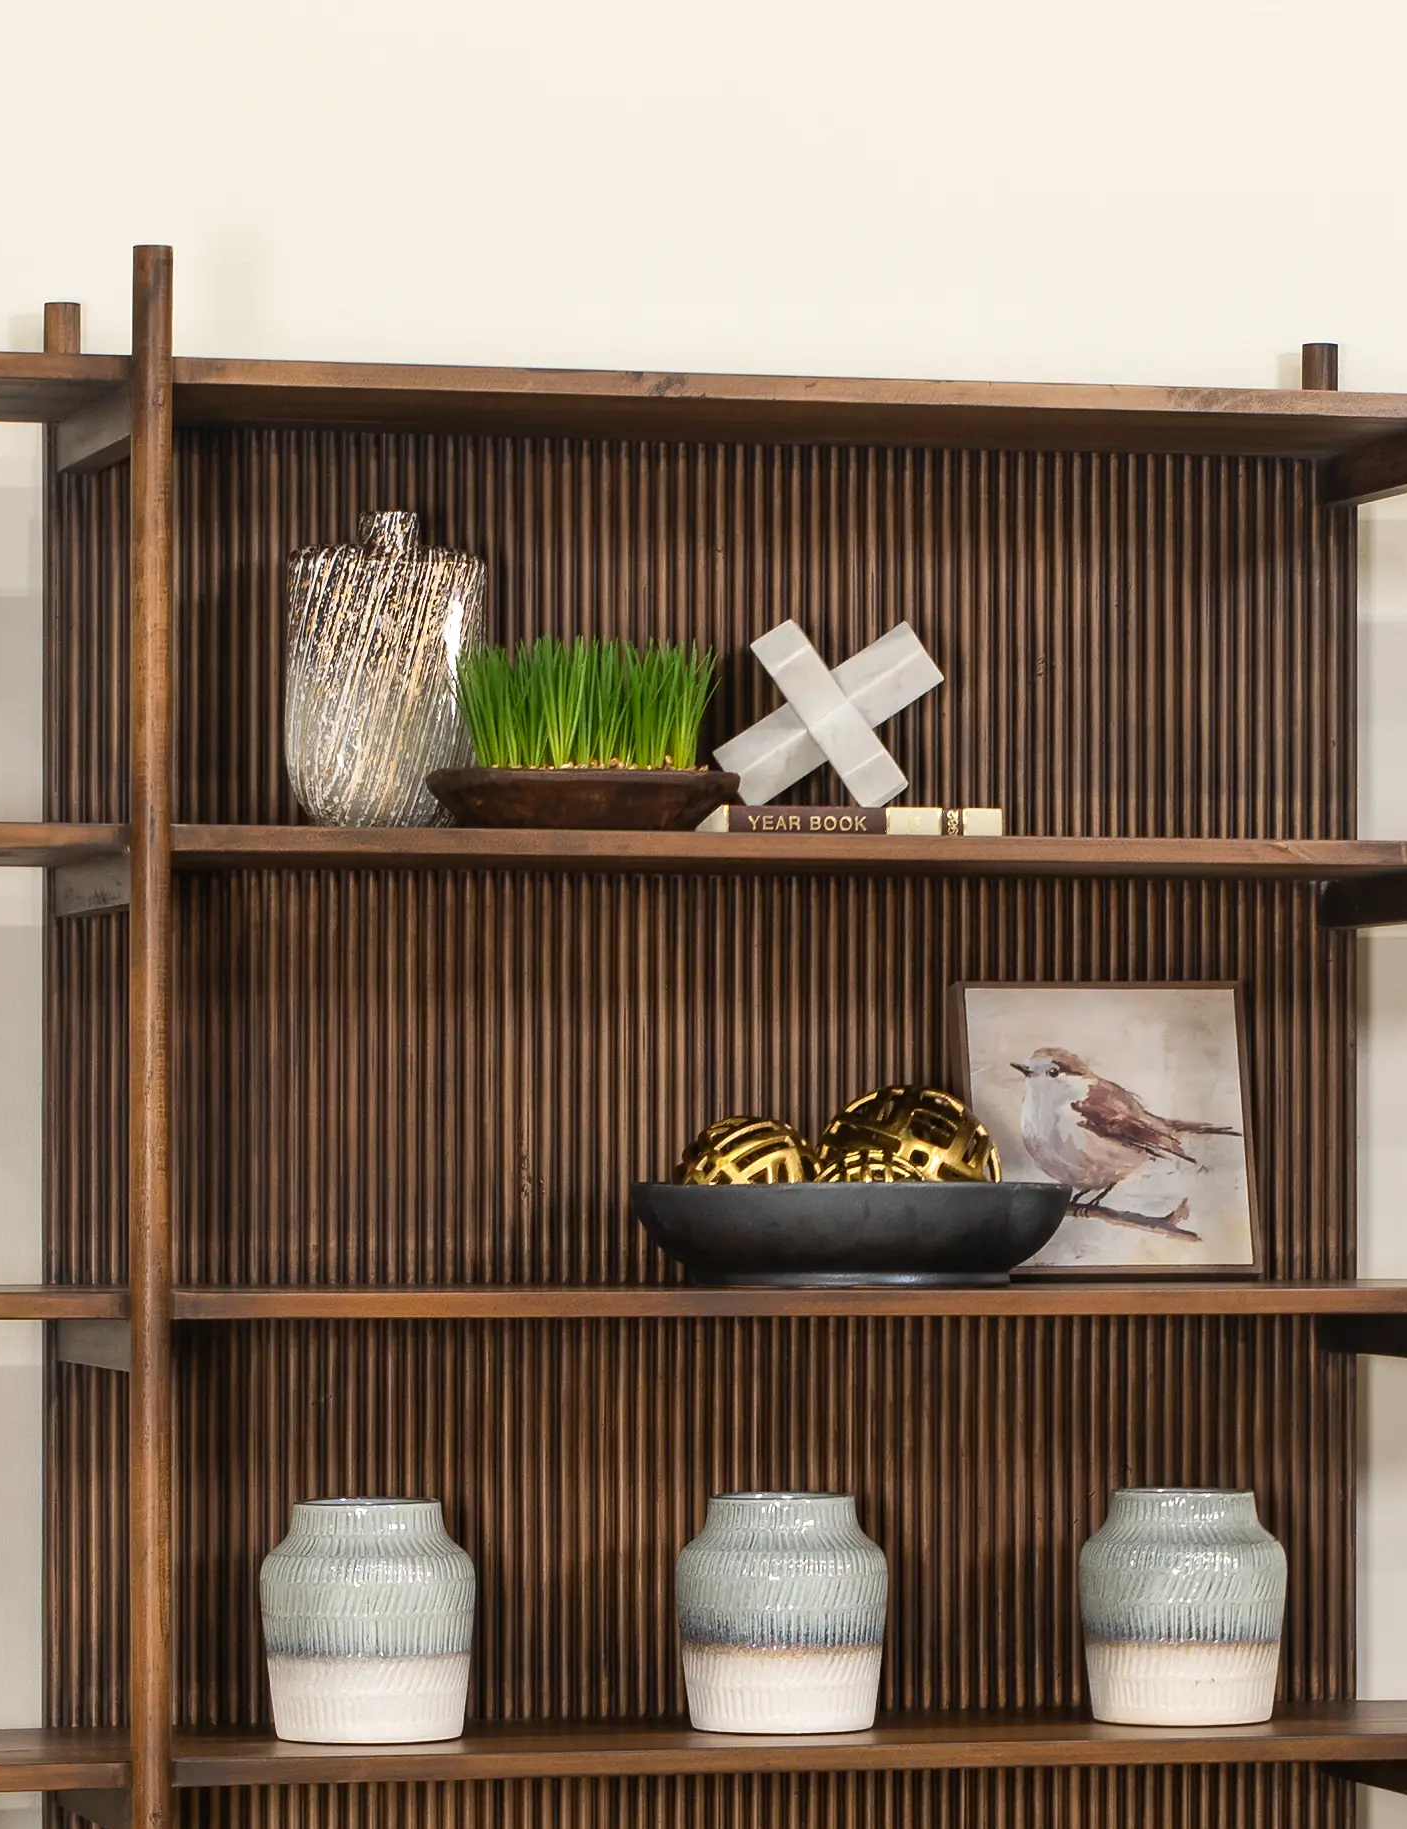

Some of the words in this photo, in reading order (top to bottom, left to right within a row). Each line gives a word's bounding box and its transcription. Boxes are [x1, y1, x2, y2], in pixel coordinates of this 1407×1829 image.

[747, 815, 801, 831] YEAR
[809, 815, 867, 832] BOOK
[947, 809, 959, 836] 982
